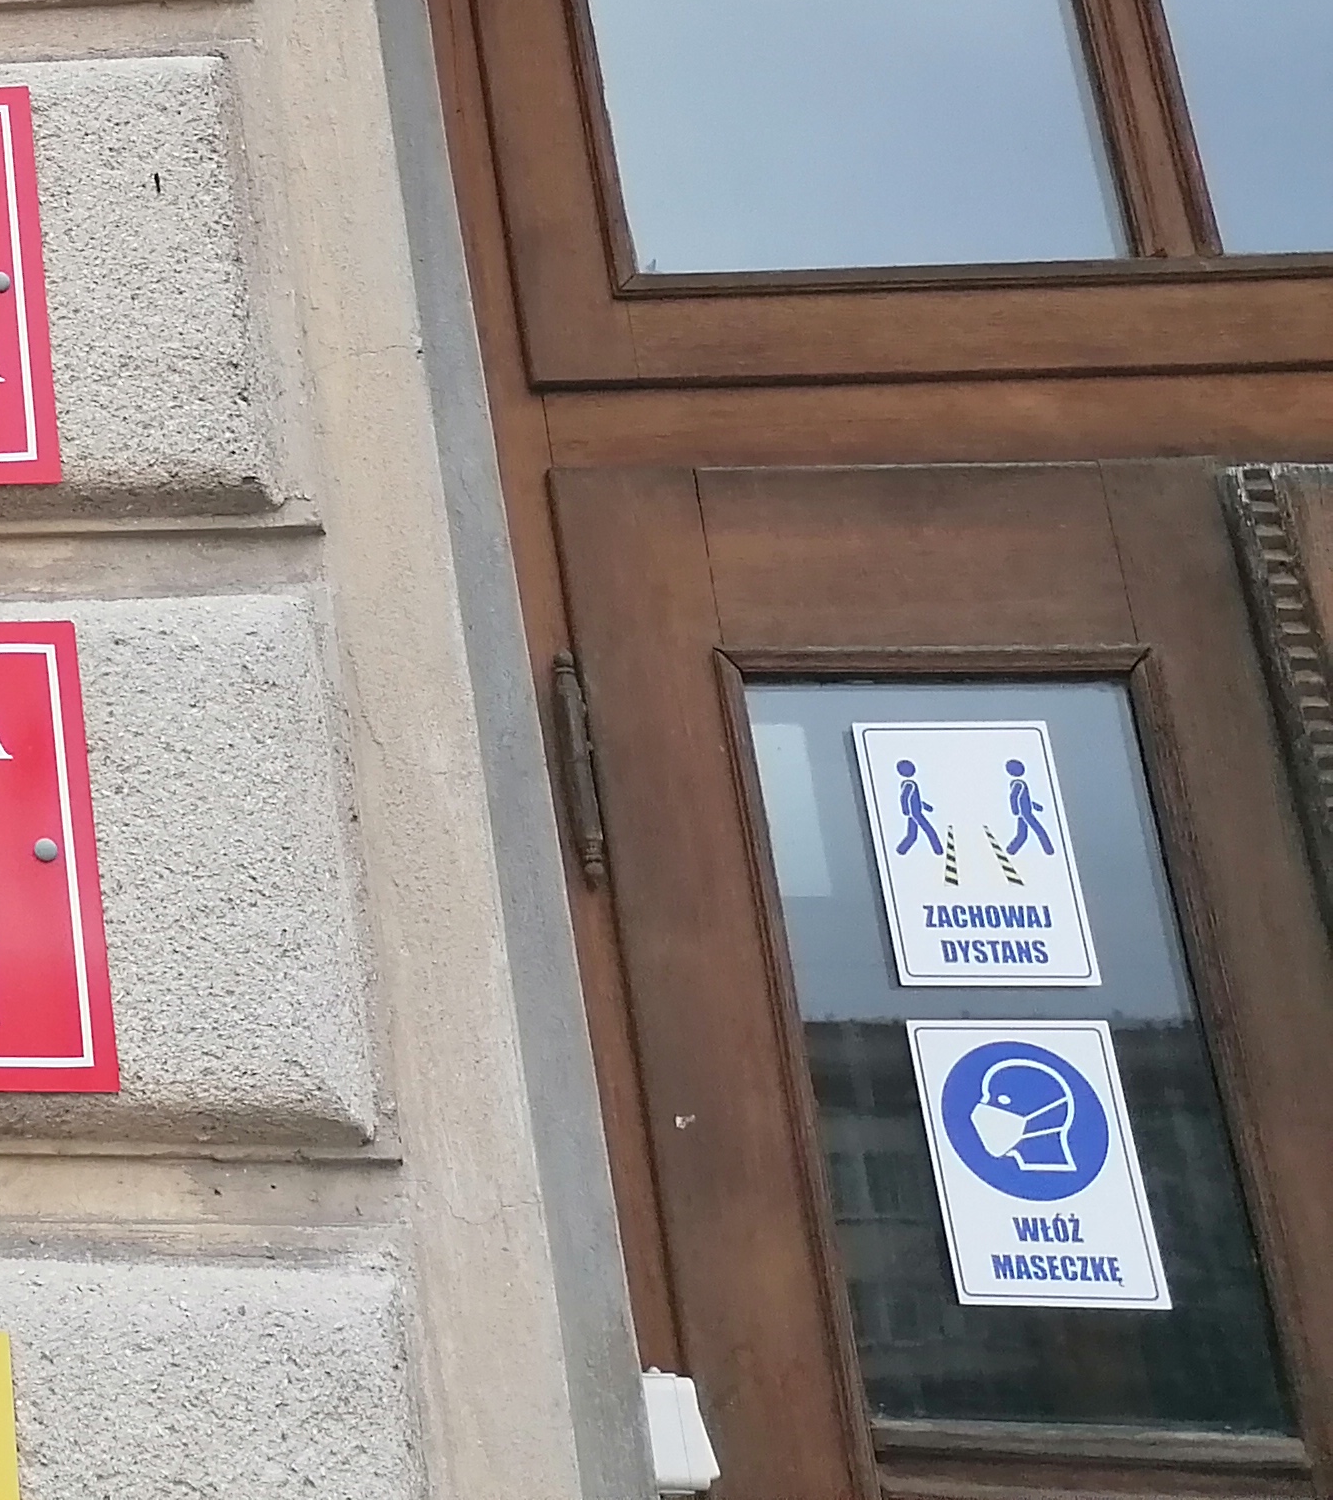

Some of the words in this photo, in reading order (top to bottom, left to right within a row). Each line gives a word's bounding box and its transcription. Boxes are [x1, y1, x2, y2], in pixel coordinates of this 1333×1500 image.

[922, 904, 1052, 929] ZACHOWAJ
[941, 939, 1049, 964] DYSTANS
[1012, 1212, 1085, 1243] WŁÓŻ
[991, 1254, 1125, 1287] MASECZKĘ
